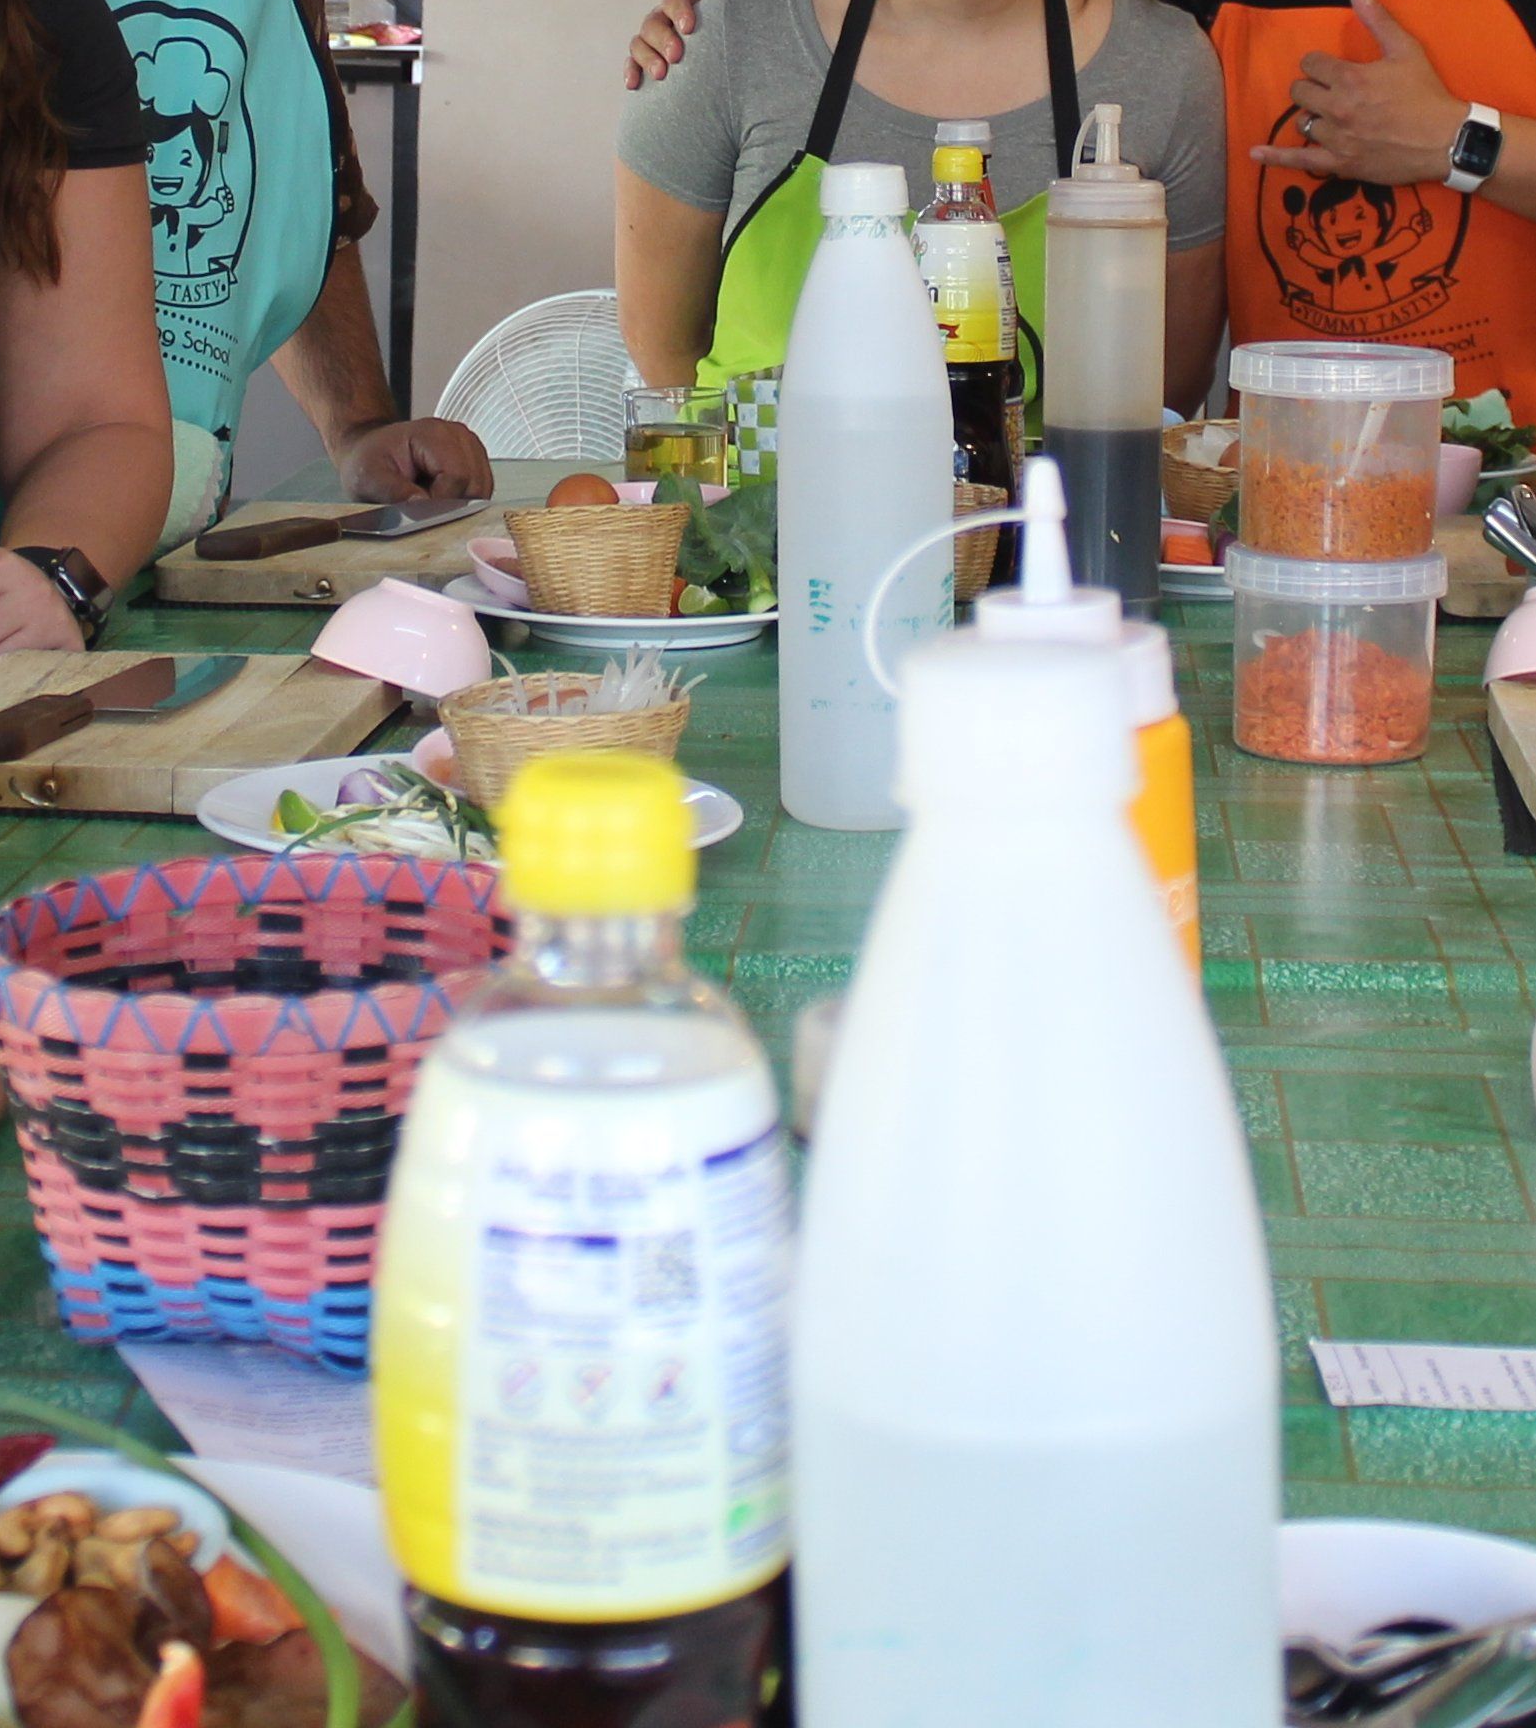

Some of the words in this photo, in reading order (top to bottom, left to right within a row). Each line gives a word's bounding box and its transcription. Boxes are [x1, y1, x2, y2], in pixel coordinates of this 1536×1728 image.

[169, 279, 221, 303] TASTY
[1302, 306, 1369, 333] YUMMY
[1377, 292, 1433, 329] TASTY
[181, 330, 231, 367] School
